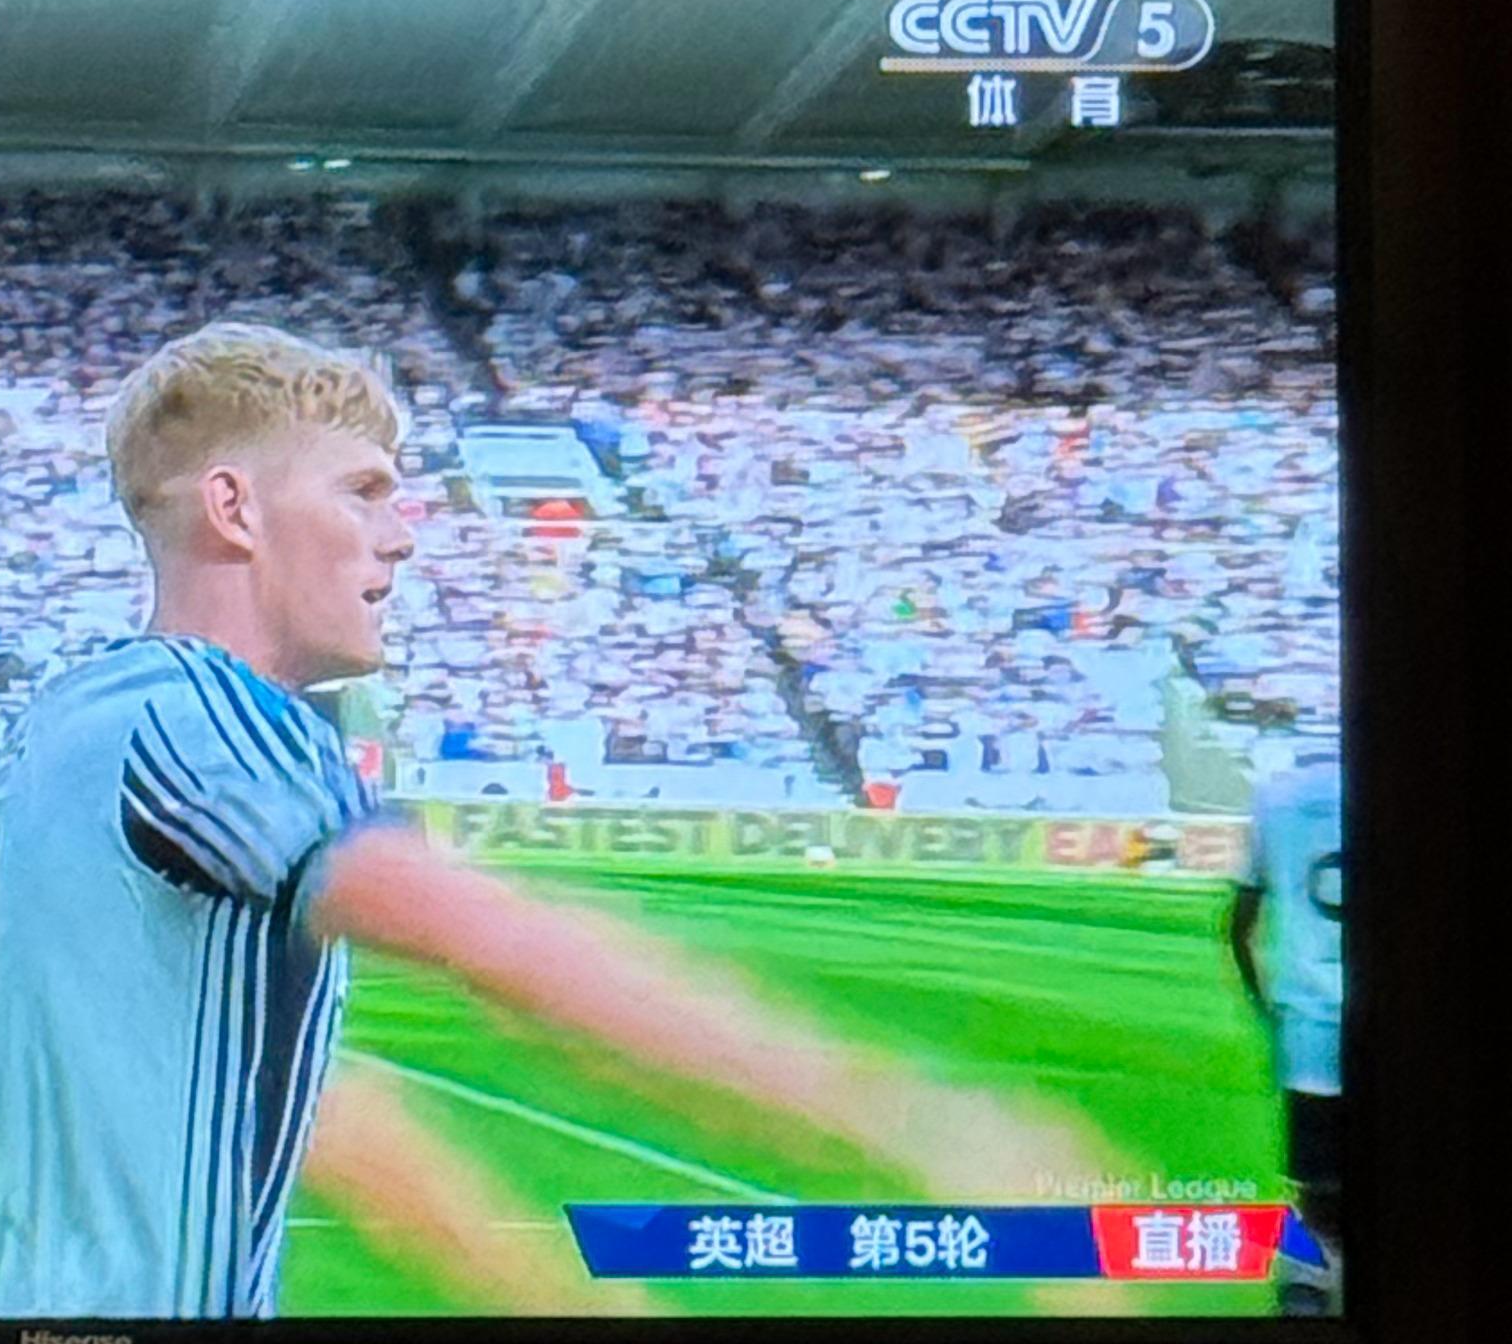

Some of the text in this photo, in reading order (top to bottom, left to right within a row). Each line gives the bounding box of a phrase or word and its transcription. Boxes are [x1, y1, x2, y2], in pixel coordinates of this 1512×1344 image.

[1137, 1, 1175, 58] 5
[966, 73, 1120, 127] 体育
[688, 1213, 991, 1270] 英超 第5轮
[1131, 1210, 1241, 1271] 直播
